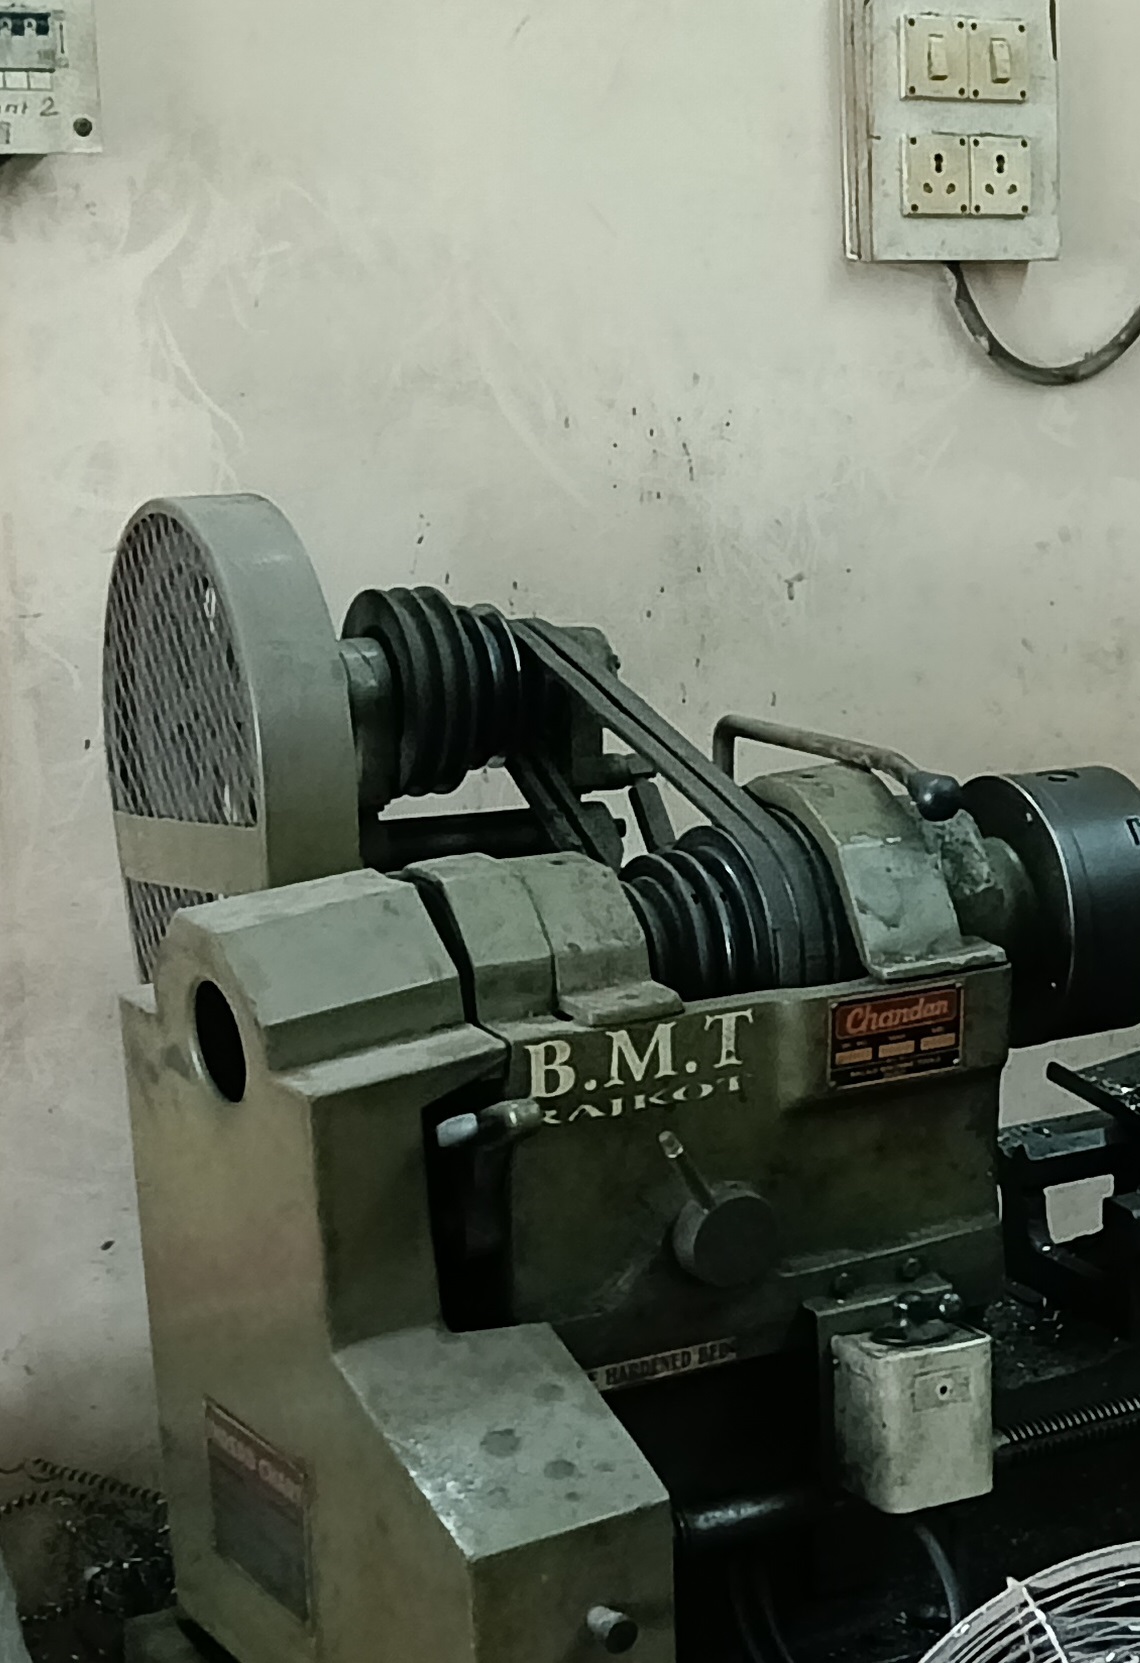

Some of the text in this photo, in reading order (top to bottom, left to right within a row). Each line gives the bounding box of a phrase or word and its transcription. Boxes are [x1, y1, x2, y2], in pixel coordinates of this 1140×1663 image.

[40, 96, 59, 117] 2
[845, 998, 950, 1035] Chandan
[523, 1008, 754, 1099] B.M.T
[605, 1349, 693, 1386] HARDENED
